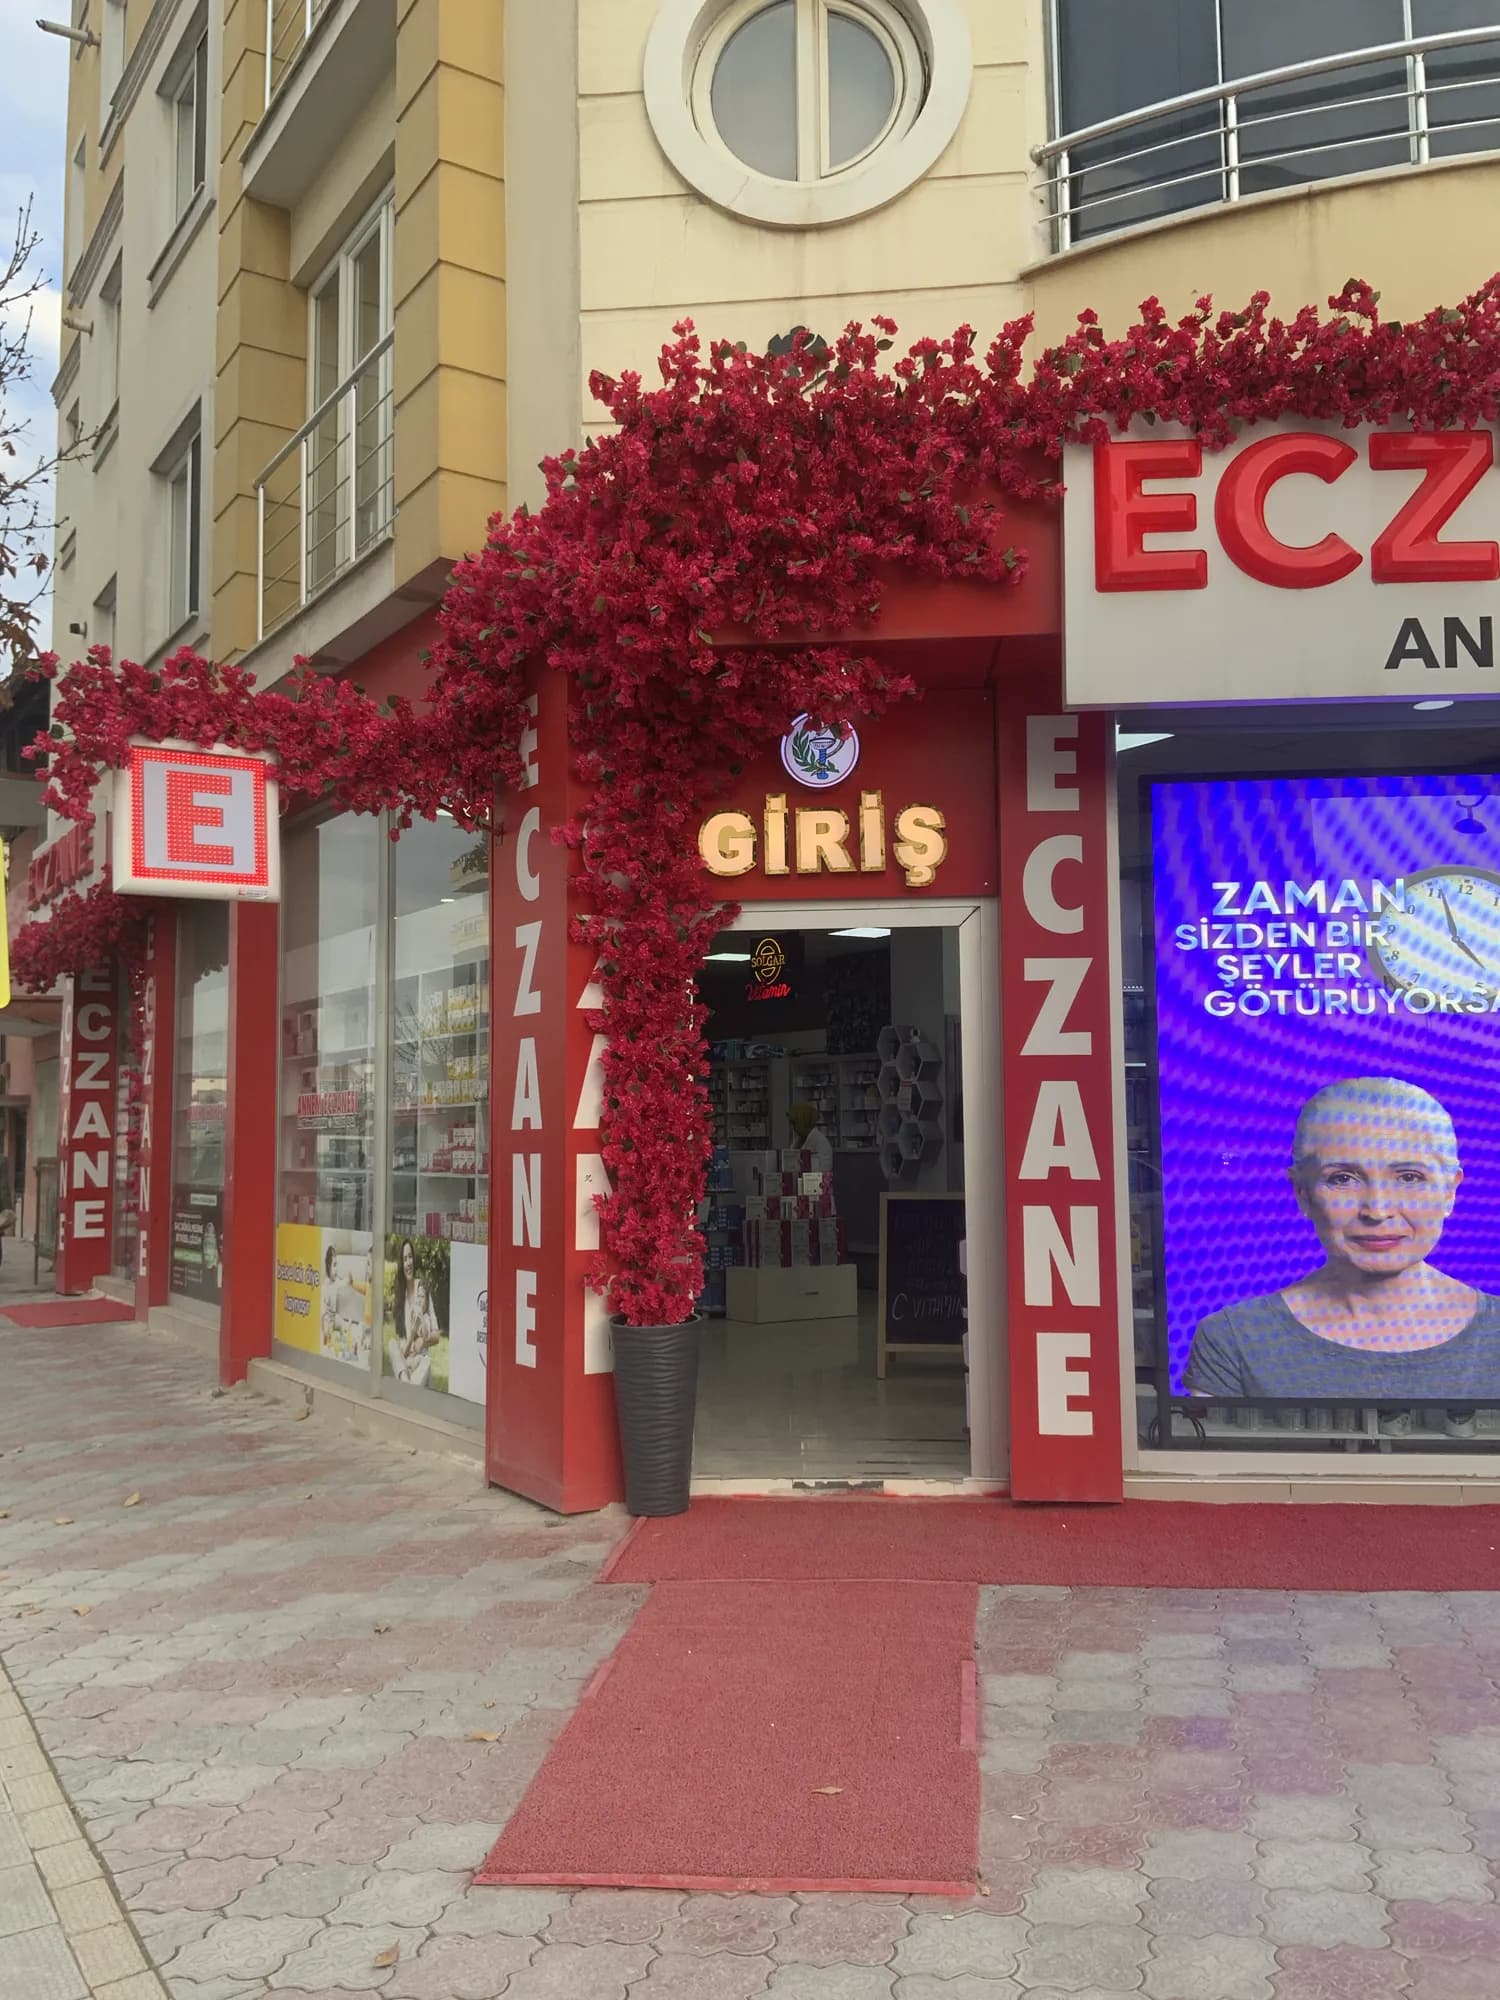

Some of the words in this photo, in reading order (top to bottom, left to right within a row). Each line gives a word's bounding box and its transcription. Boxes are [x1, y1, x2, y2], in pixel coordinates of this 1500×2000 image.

[1093, 430, 1500, 592] ECZ
[1384, 616, 1494, 669] AN
[166, 770, 234, 865] E
[698, 790, 948, 887] GİRİŞ
[1211, 878, 1406, 916] ZAMAN
[1175, 916, 1316, 950] SİZDEN
[1326, 913, 1390, 947] BİR
[751, 954, 785, 968] SOLGAR
[1216, 952, 1362, 988] ŞEYLER
[1203, 980, 1500, 1017] GÖTÜRÜYORS
[511, 694, 543, 1368] ECZANE
[1018, 715, 1101, 1437] ECZANE
